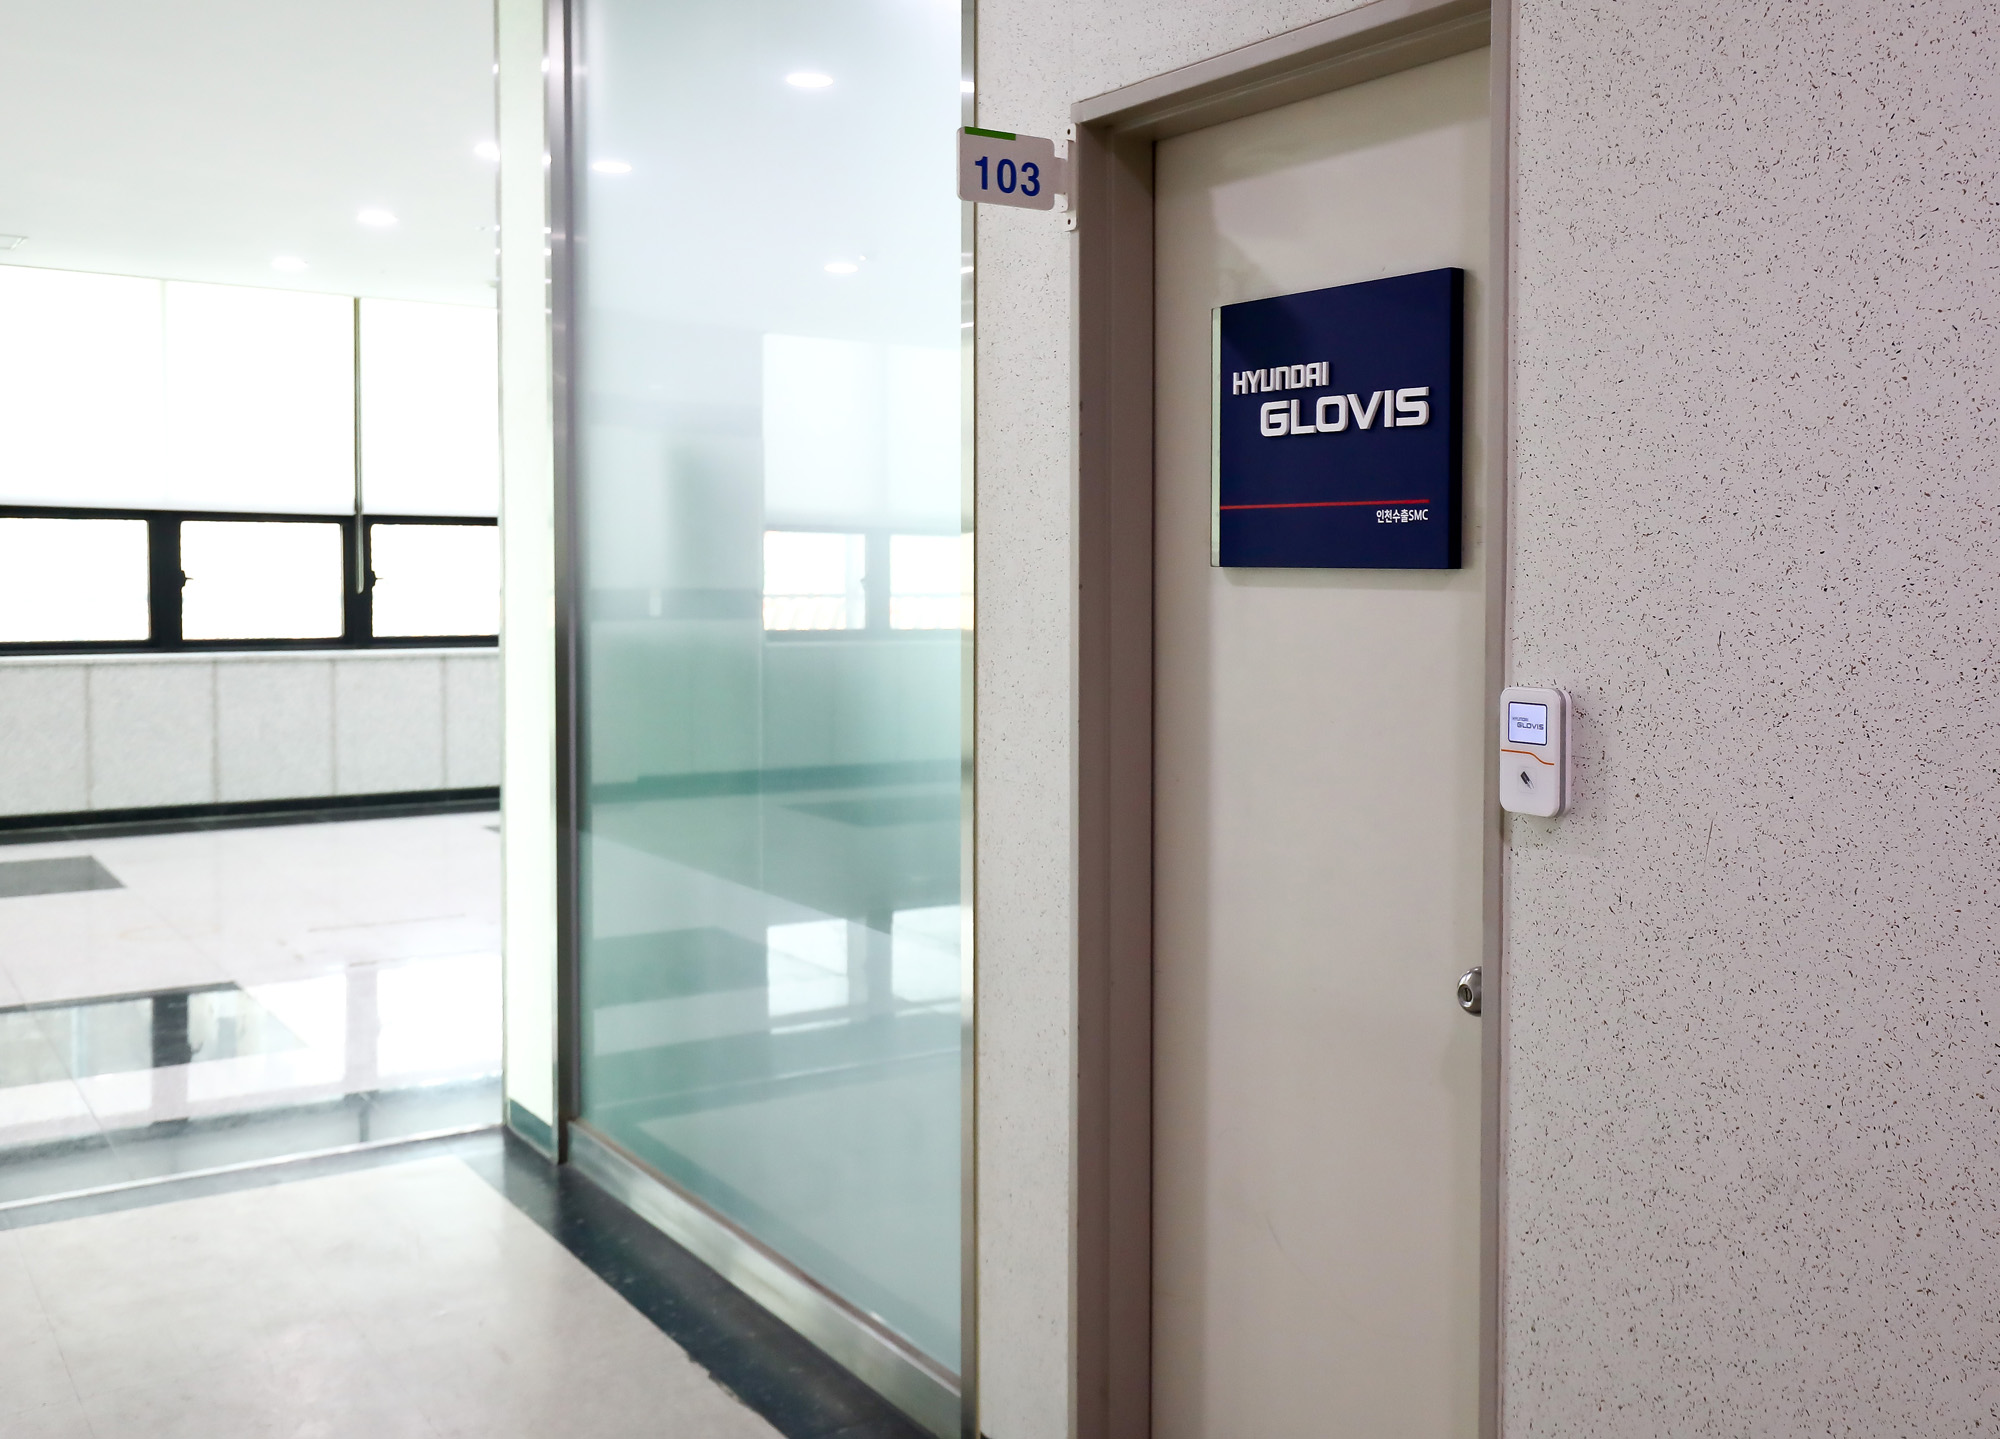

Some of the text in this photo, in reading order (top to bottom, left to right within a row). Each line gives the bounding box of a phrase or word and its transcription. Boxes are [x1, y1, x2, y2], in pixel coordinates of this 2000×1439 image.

[975, 156, 1040, 197] 103
[1232, 361, 1330, 396] HYUNDAI
[1260, 386, 1430, 438] GLOVIS
[1376, 508, 1429, 524] 인천수출SMC
[1516, 721, 1544, 730] GLOVIS
